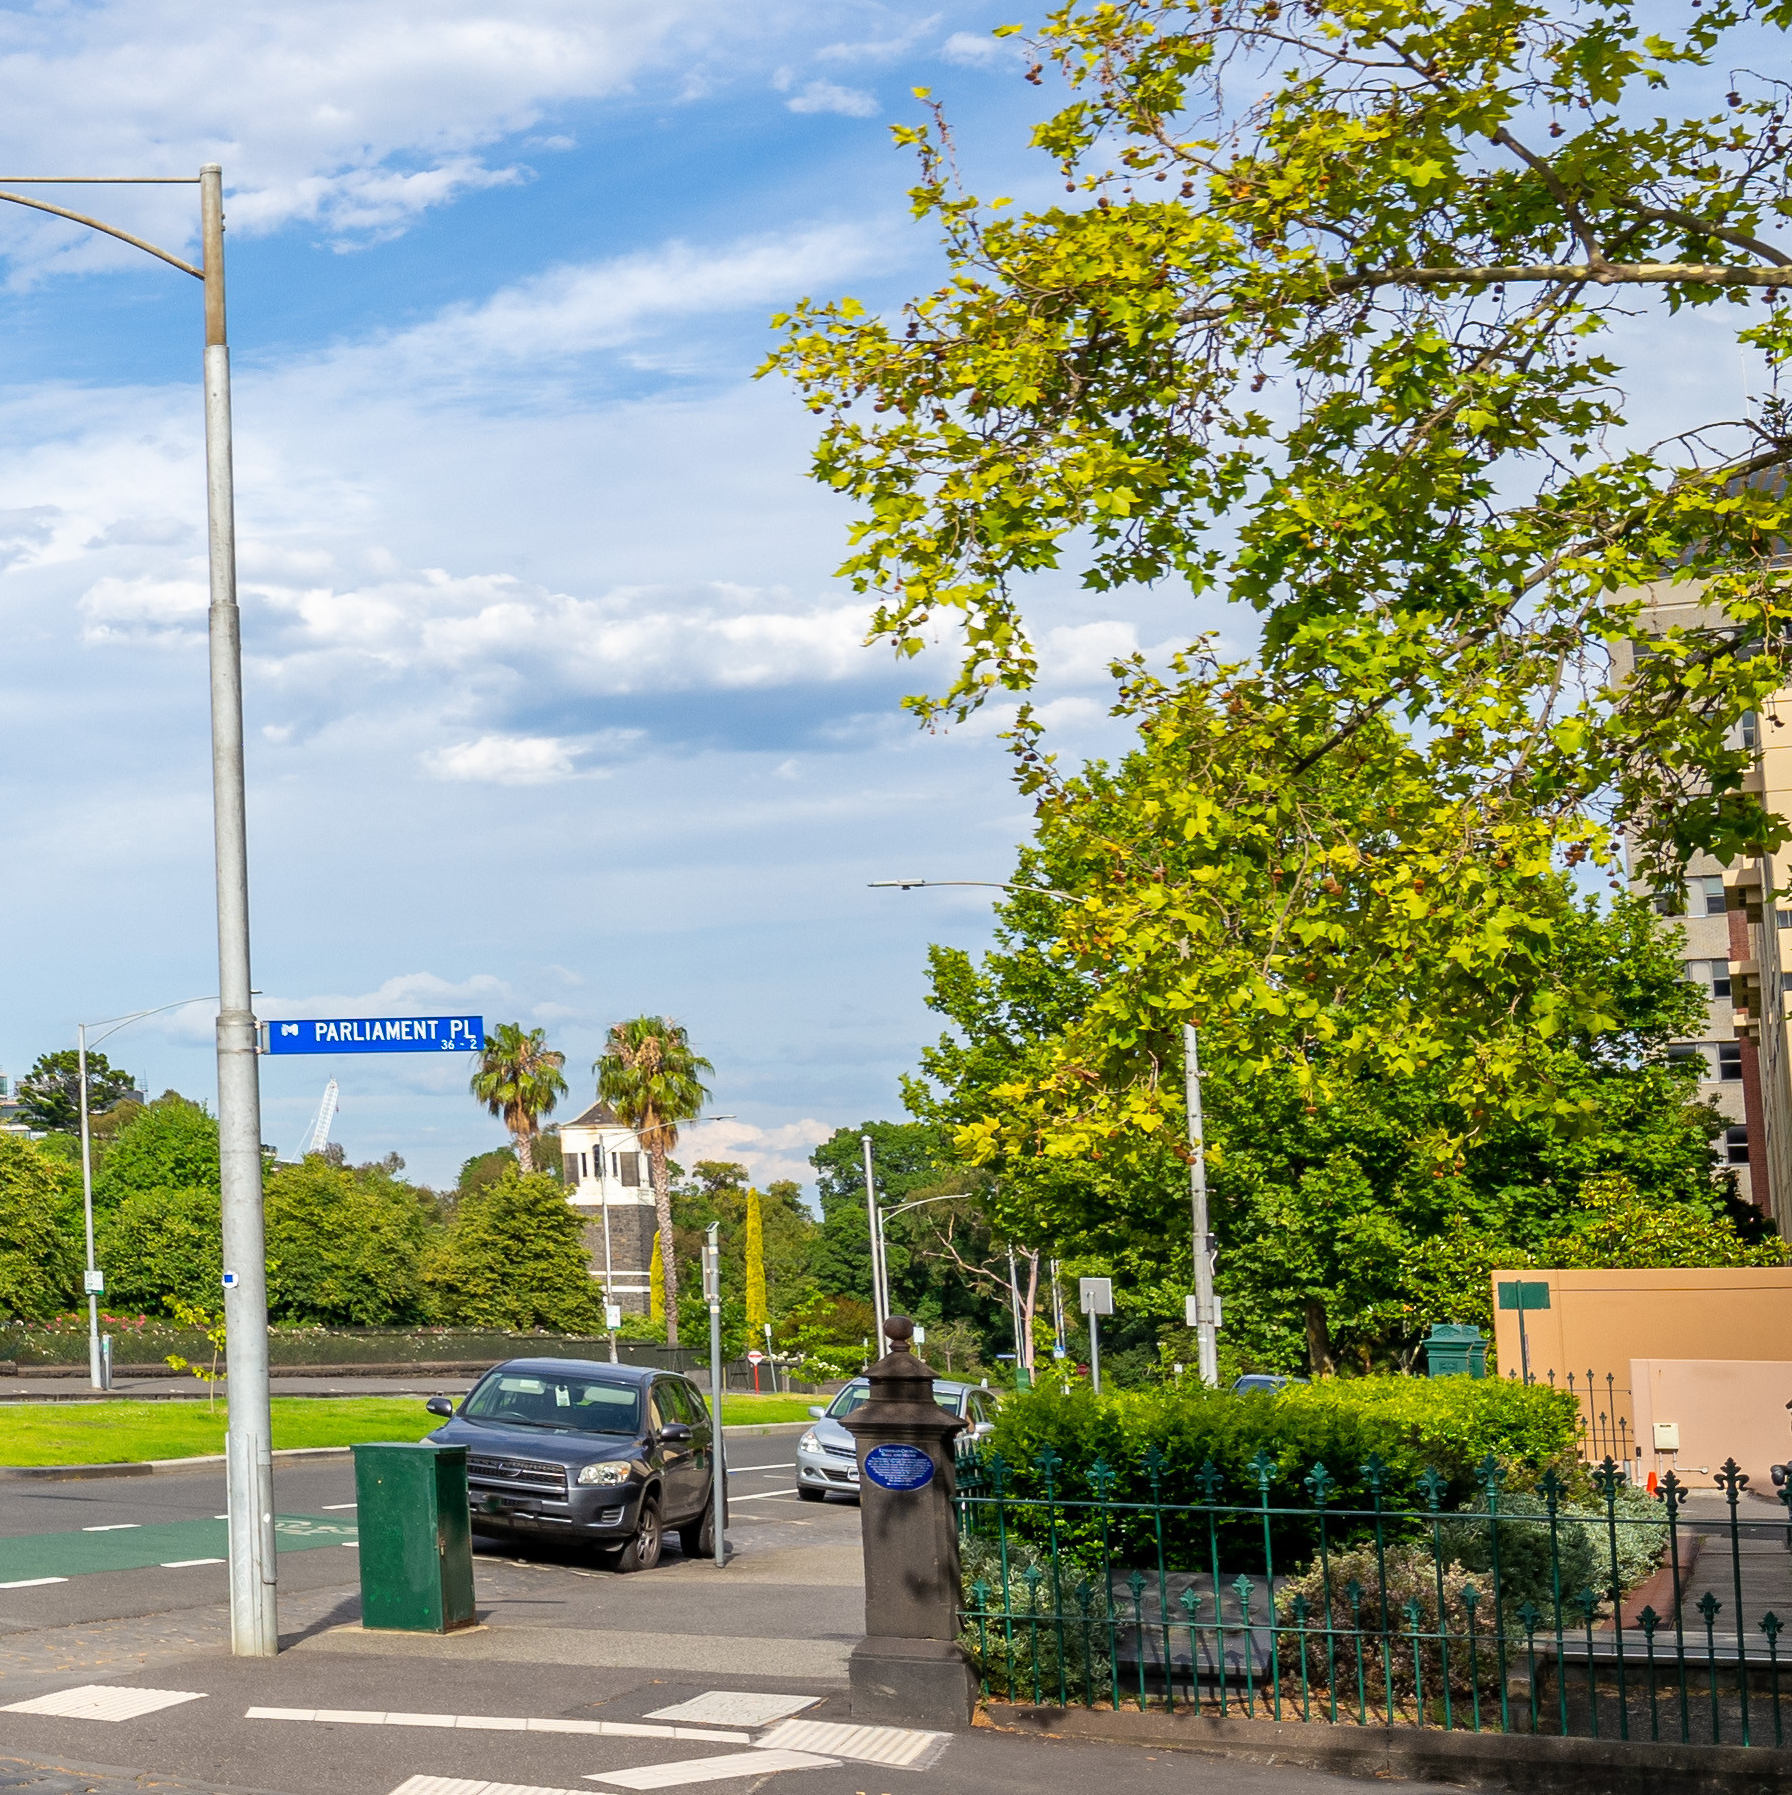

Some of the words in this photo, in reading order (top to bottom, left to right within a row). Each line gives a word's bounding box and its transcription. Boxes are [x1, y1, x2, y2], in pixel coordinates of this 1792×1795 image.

[315, 1020, 438, 1042] PARLIAMENT
[450, 1019, 477, 1040] PL
[440, 1040, 455, 1050] 36
[469, 1039, 478, 1049] 2
